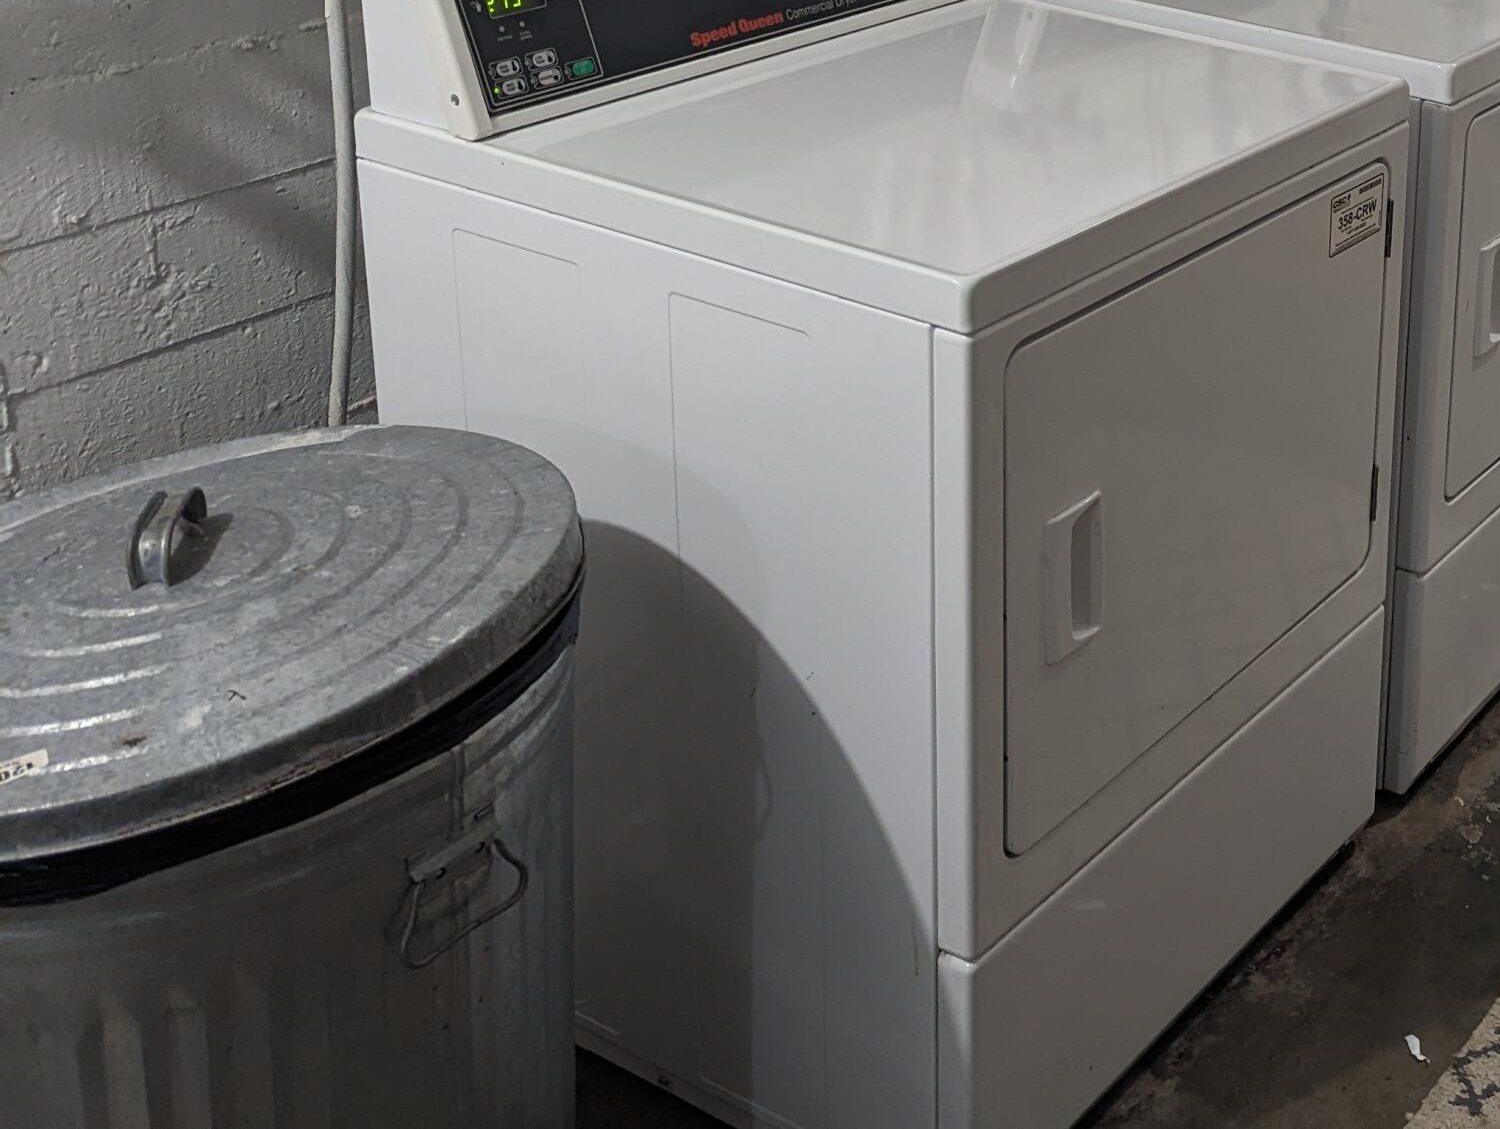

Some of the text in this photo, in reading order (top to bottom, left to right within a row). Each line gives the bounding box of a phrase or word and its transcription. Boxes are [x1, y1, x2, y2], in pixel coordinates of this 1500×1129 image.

[690, 20, 738, 47] Speed
[738, 11, 785, 34] Queen
[1338, 198, 1377, 230] 358-CRW
